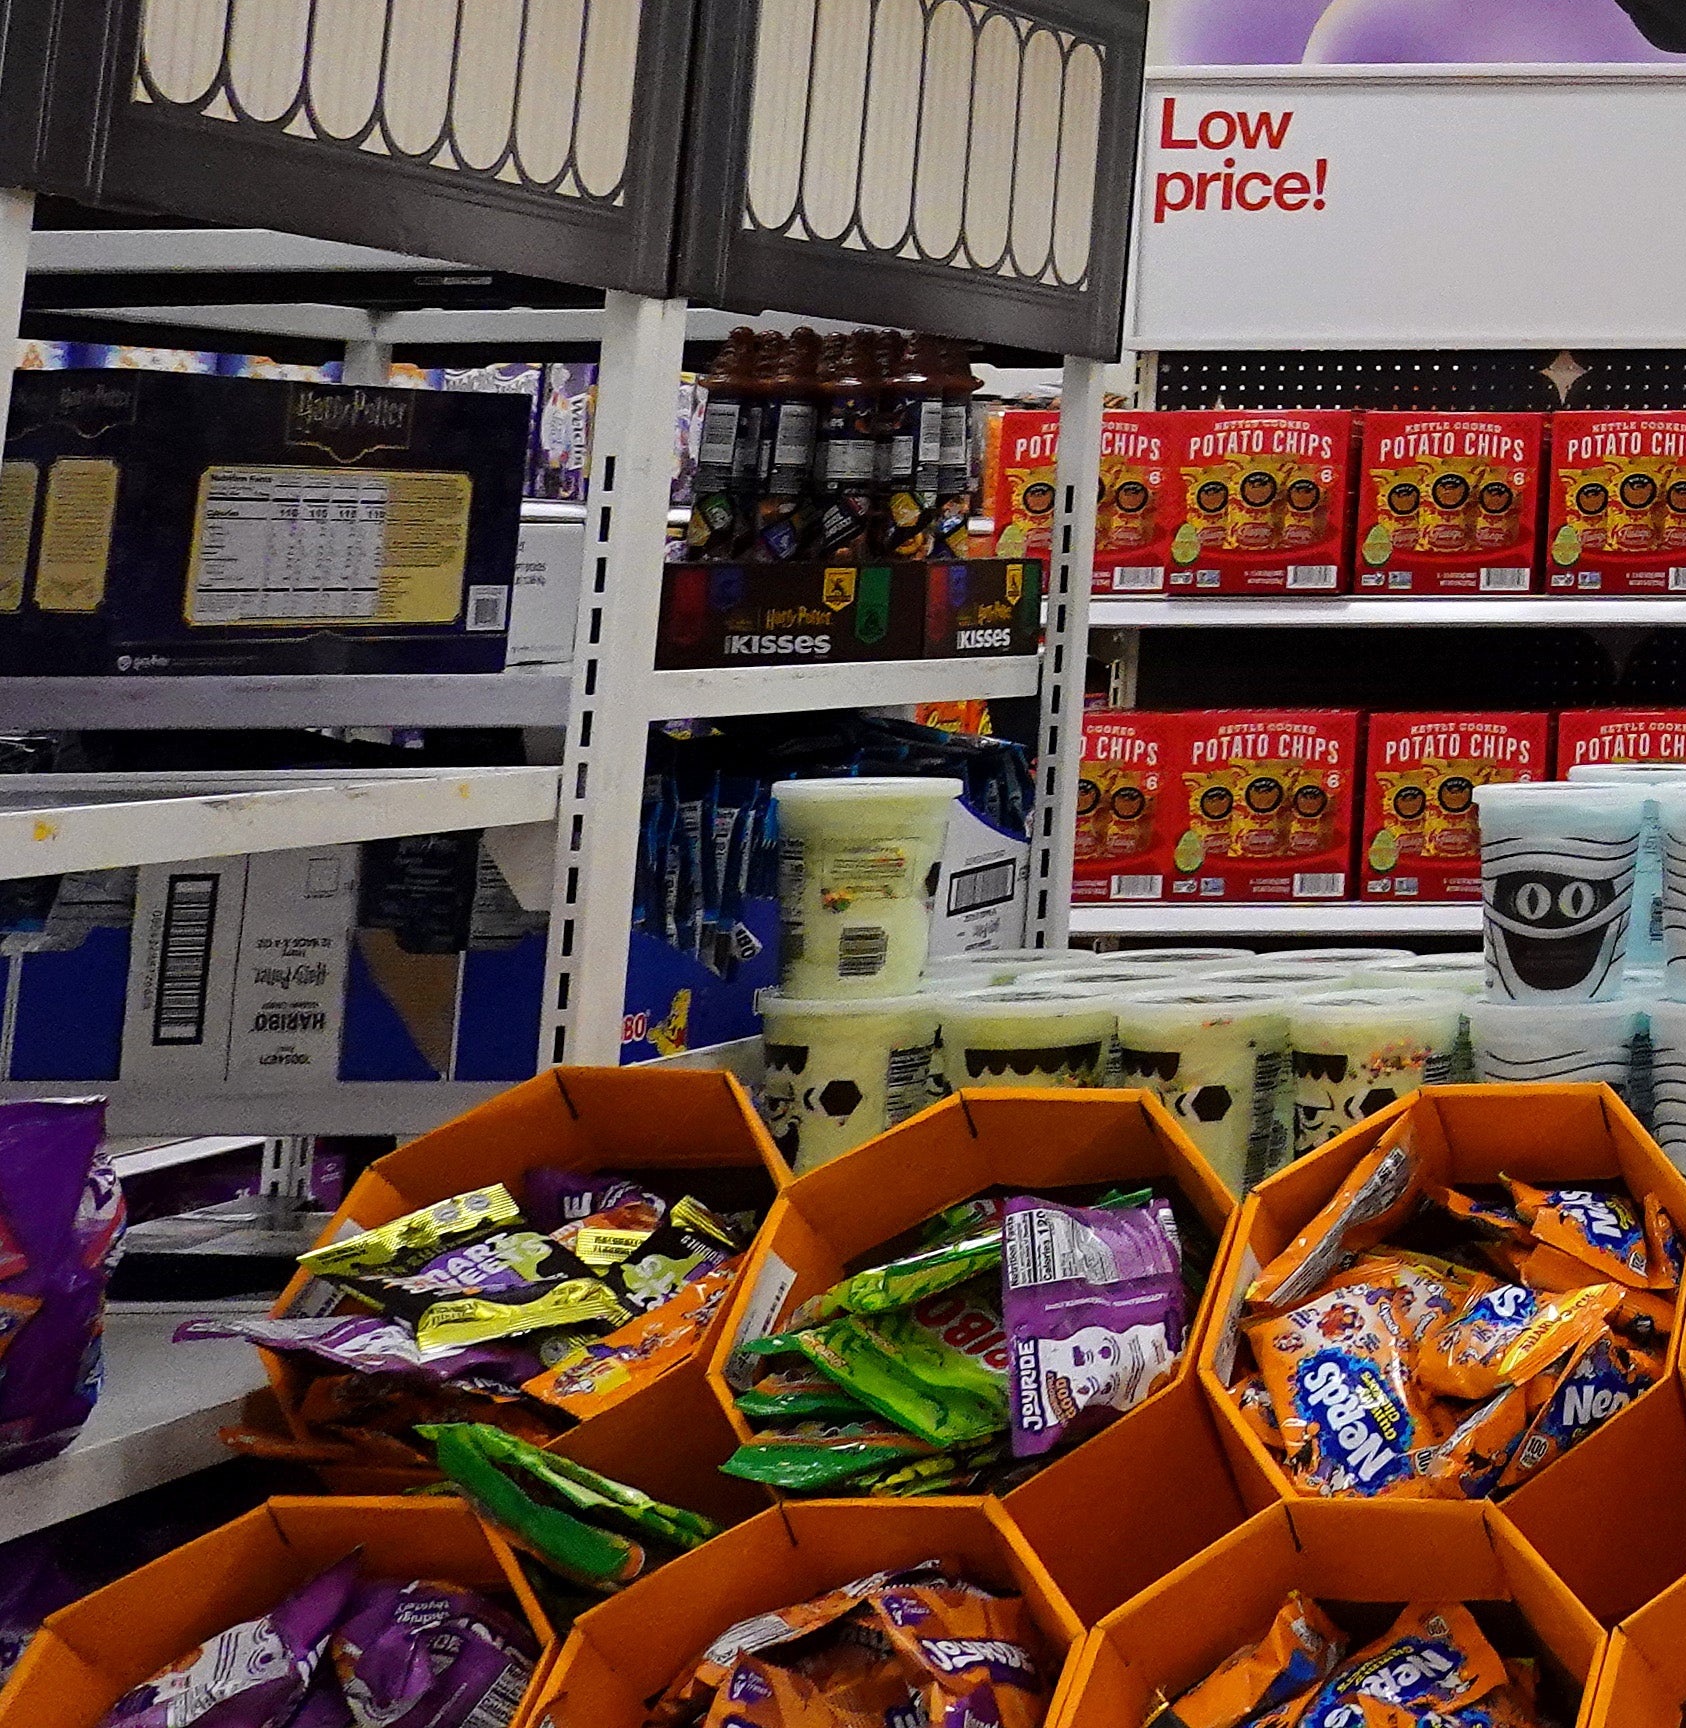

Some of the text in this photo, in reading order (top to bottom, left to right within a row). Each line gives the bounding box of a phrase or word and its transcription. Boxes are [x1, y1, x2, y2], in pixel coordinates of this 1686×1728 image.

[1160, 97, 1294, 150] Low
[1154, 157, 1328, 223] price!
[1101, 432, 1161, 461] CHIPS
[1188, 430, 1333, 460] POTATO CHIPS
[1379, 432, 1525, 463] POTATO CHIPS
[1567, 431, 1643, 462] POTATO
[1096, 735, 1159, 766] CHIPS
[1192, 733, 1339, 765] POTATO CHIPS
[1385, 733, 1531, 765] POTATO CHIPS
[1575, 733, 1650, 765] POTATO
[252, 1012, 326, 1034] HARIBO
[1003, 1238, 1019, 1288] Nutrition
[1035, 1239, 1054, 1282] Calories
[1016, 1338, 1044, 1431] JOYRIDE
[1304, 1360, 1395, 1483] NERDS
[1526, 1434, 1548, 1457] 100
